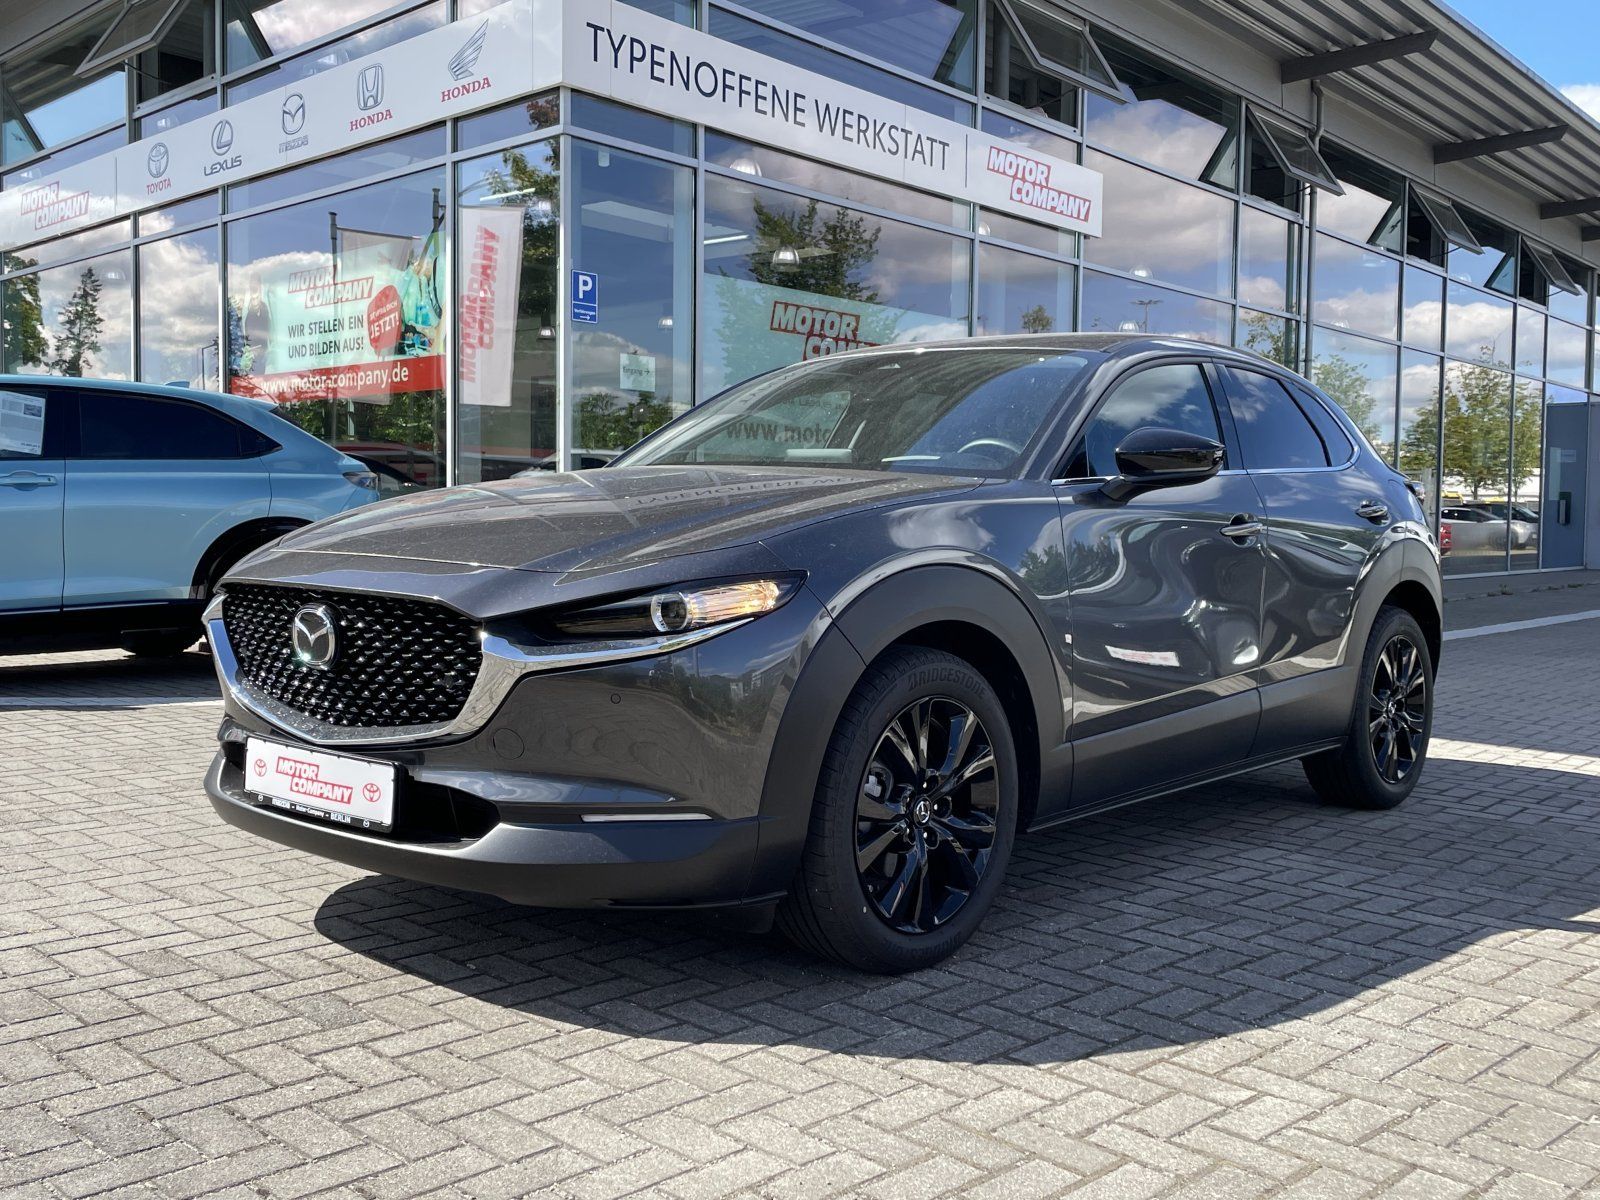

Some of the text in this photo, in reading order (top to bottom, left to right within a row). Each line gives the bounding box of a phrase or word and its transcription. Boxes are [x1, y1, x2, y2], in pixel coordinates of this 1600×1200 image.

[440, 77, 491, 103] HONDA
[586, 21, 950, 171] TYPENOFFENE WERKSTATT
[350, 109, 393, 132] HONDA
[204, 155, 242, 176] LEXUS
[988, 147, 1050, 187] MOTOR
[22, 183, 59, 214] MOTOR
[146, 178, 172, 196] TOYOTA
[1010, 178, 1091, 221] COMPANY
[36, 192, 88, 230] COMPANY
[289, 267, 335, 293] MOTOR
[305, 278, 372, 308] COMPANY
[579, 275, 592, 299] P
[288, 315, 364, 338] WIR STELLEN EIN
[370, 312, 399, 340] JETZT!
[771, 302, 859, 340] MOTOR
[288, 337, 364, 359] UND BILDEN AUS!
[260, 362, 409, 393] www.motor-company.de
[906, 667, 987, 698] BRIDGESTONE
[277, 757, 319, 780] MOTOR
[291, 777, 353, 804] COMPANY
